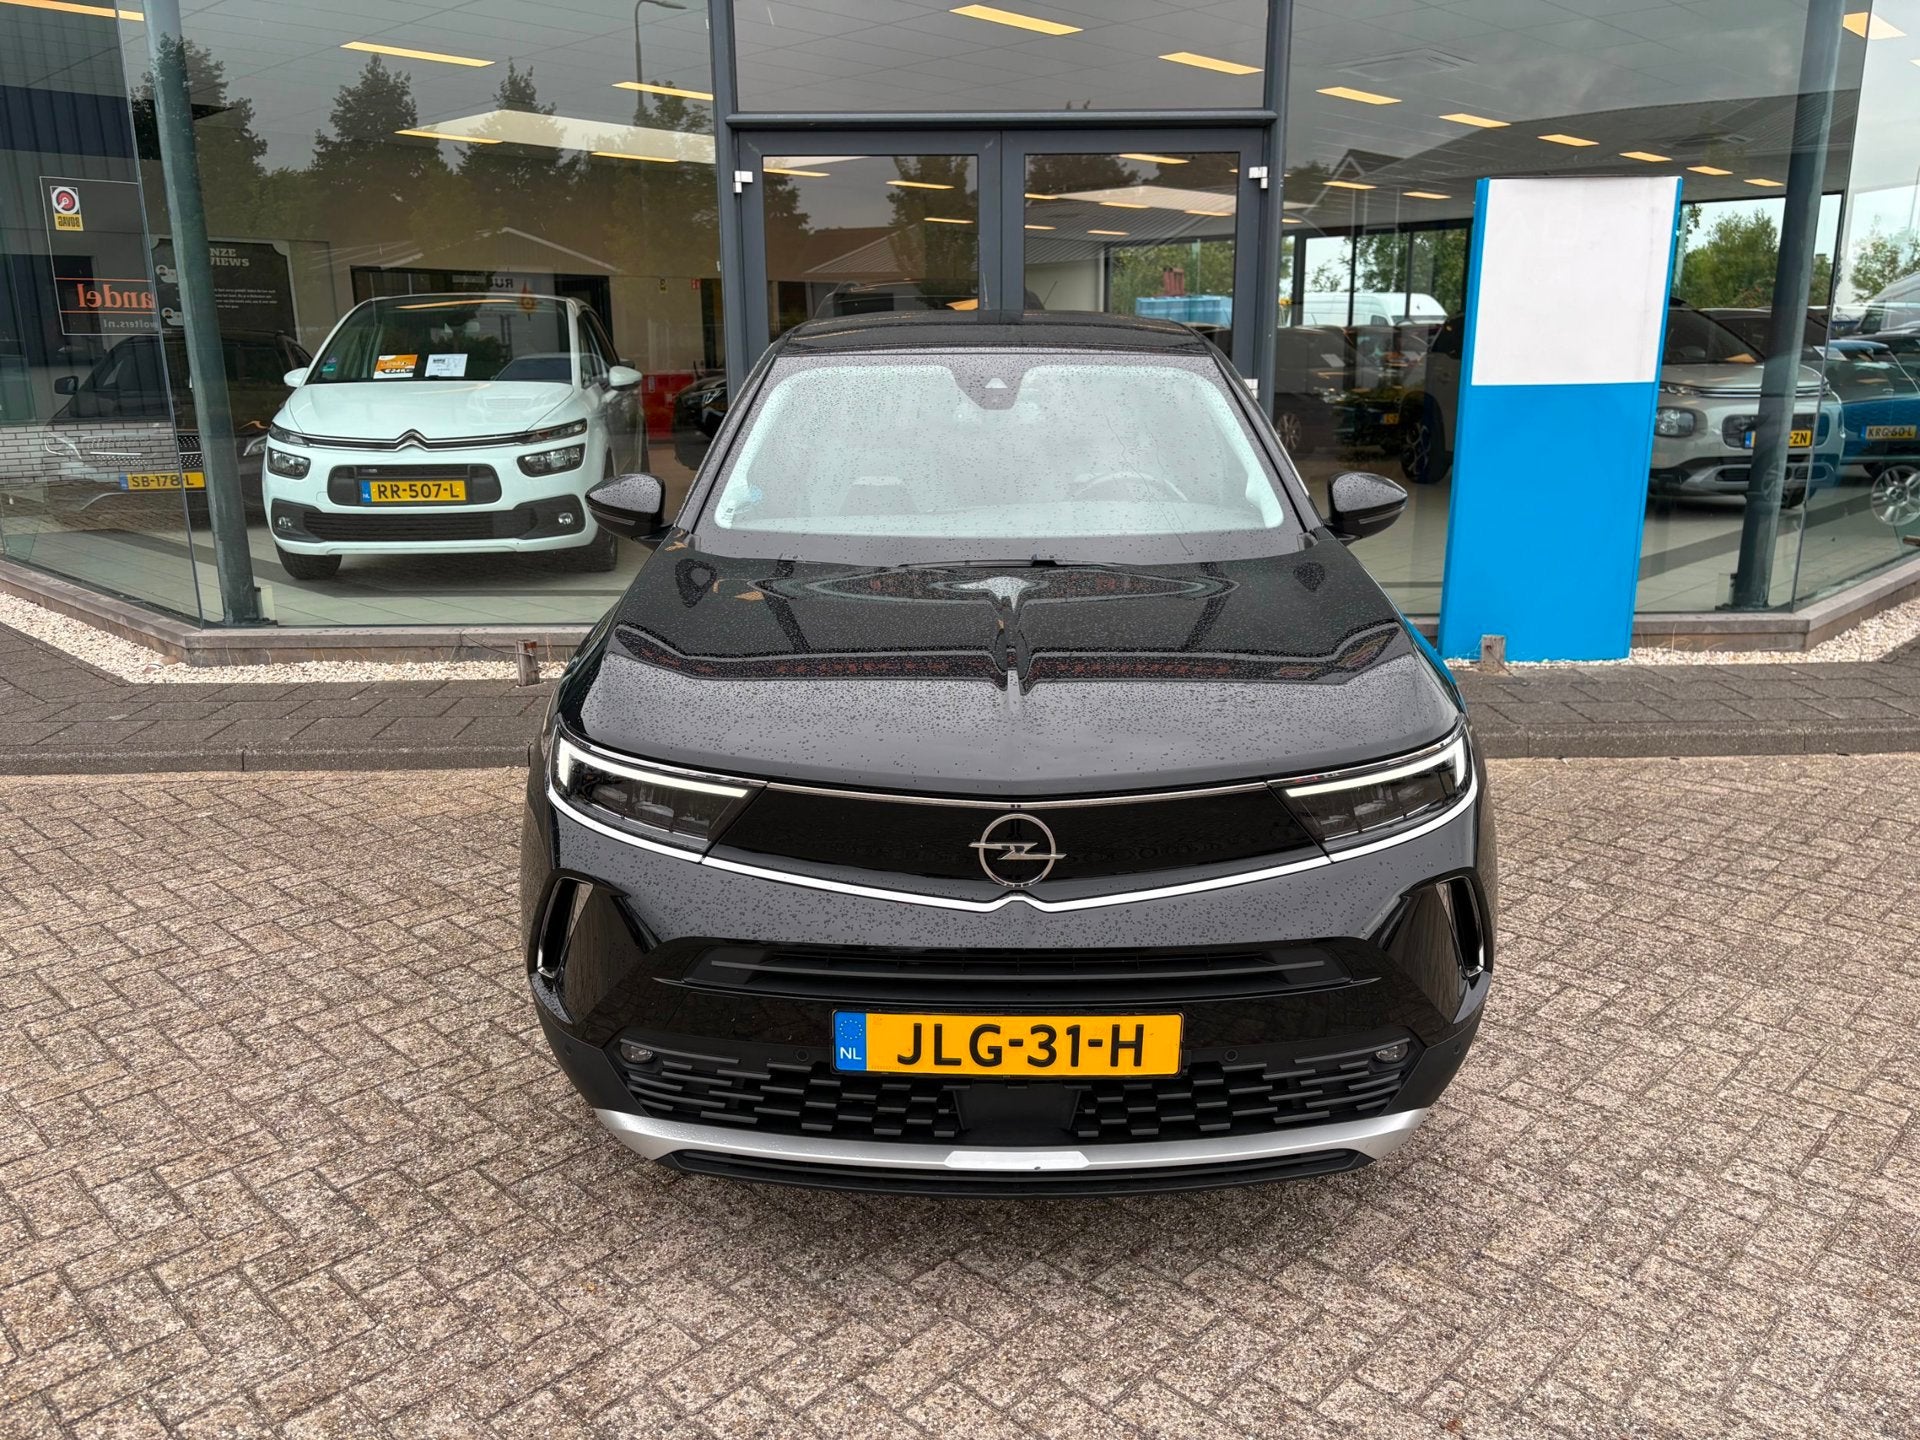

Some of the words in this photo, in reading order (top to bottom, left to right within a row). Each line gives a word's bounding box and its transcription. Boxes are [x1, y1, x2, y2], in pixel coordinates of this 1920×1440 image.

[209, 248, 237, 257] NZE
[377, 483, 460, 499] RR-507-L
[839, 1046, 862, 1060] NL
[897, 1023, 1144, 1067] JLG-31-H
